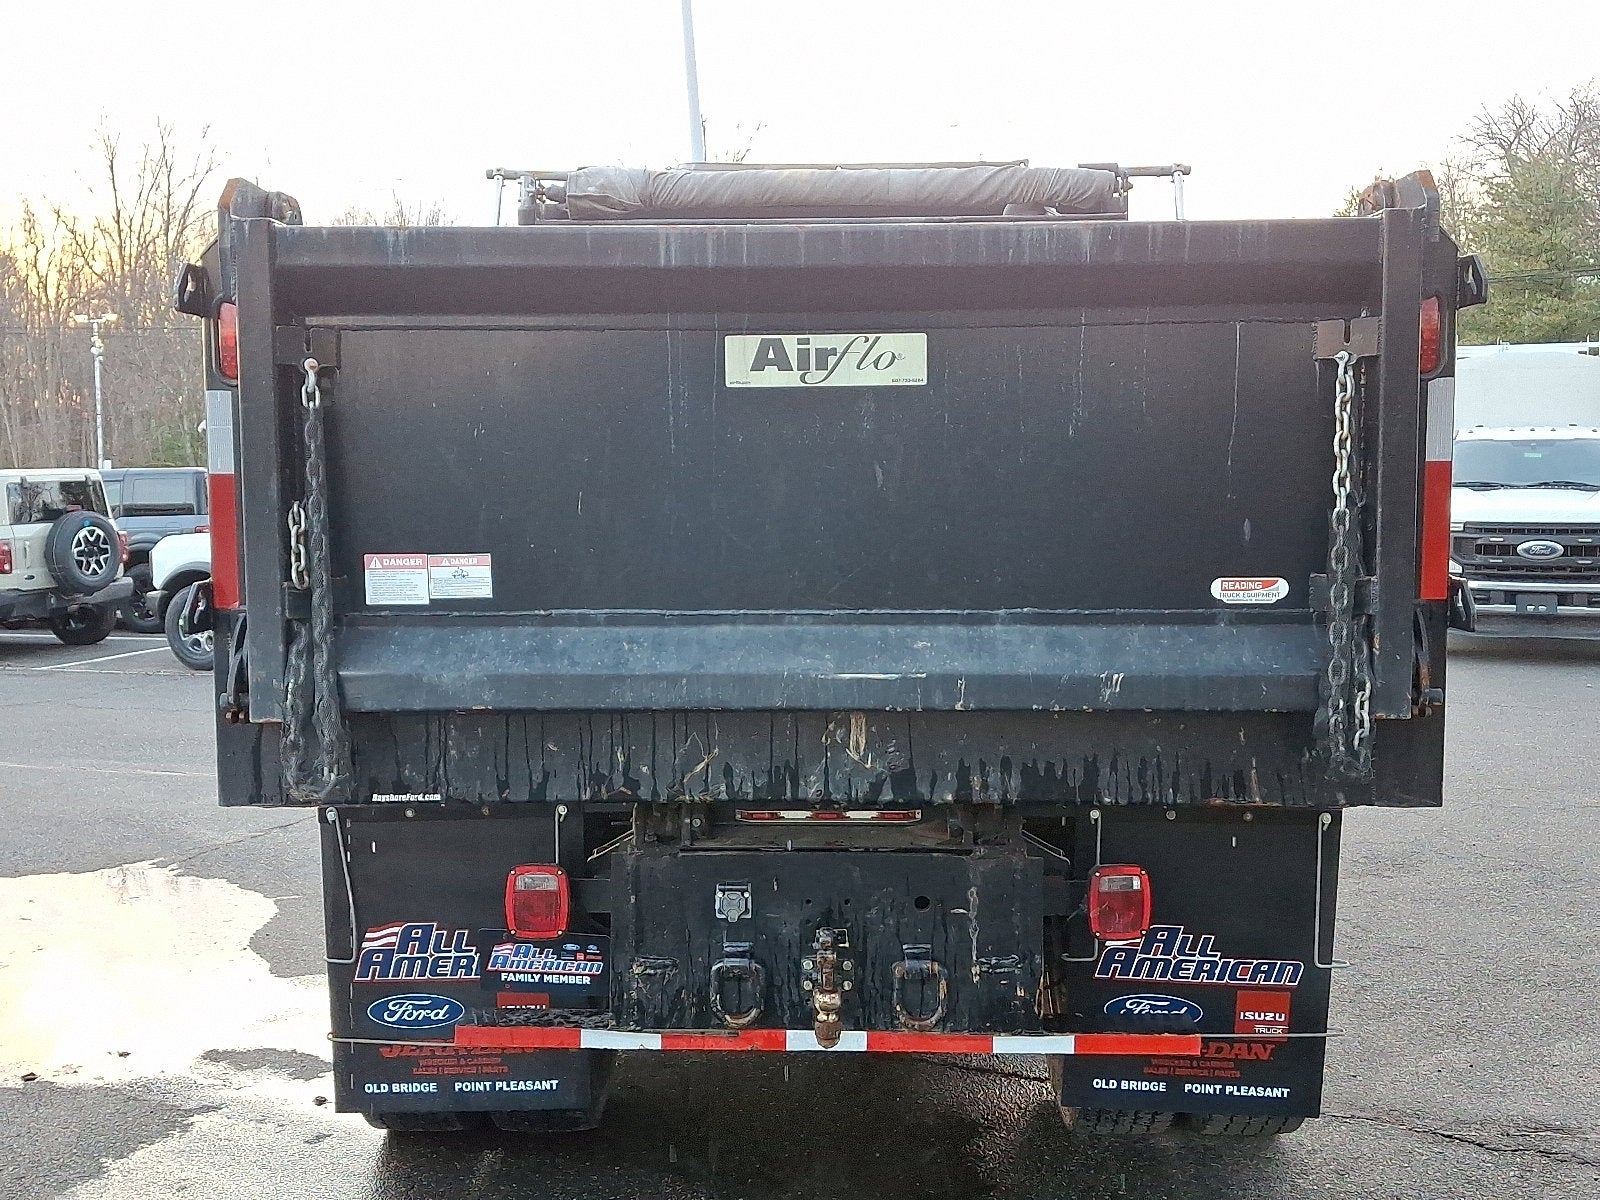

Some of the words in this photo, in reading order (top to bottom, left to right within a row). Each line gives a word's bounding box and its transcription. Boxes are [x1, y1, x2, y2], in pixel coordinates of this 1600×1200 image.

[749, 335, 899, 385] Airflo
[383, 558, 423, 566] DANGER
[1222, 581, 1263, 590] READING
[487, 953, 604, 974] AMERICAN
[1095, 946, 1304, 986] AMERICAN
[501, 973, 541, 983] FAMILY
[543, 974, 591, 985] MEMBER
[383, 999, 450, 1022] Ford
[1240, 1011, 1286, 1021] ISUZU
[364, 1083, 389, 1093] OLD
[392, 1082, 438, 1093] BRIDGE
[454, 1081, 493, 1092] POINT
[495, 1079, 559, 1091] PLEASANT
[1092, 1078, 1118, 1090] OLD
[1120, 1080, 1167, 1092] BRIDGE
[1184, 1083, 1222, 1095] POINT
[1225, 1085, 1290, 1098] PLEASANT
